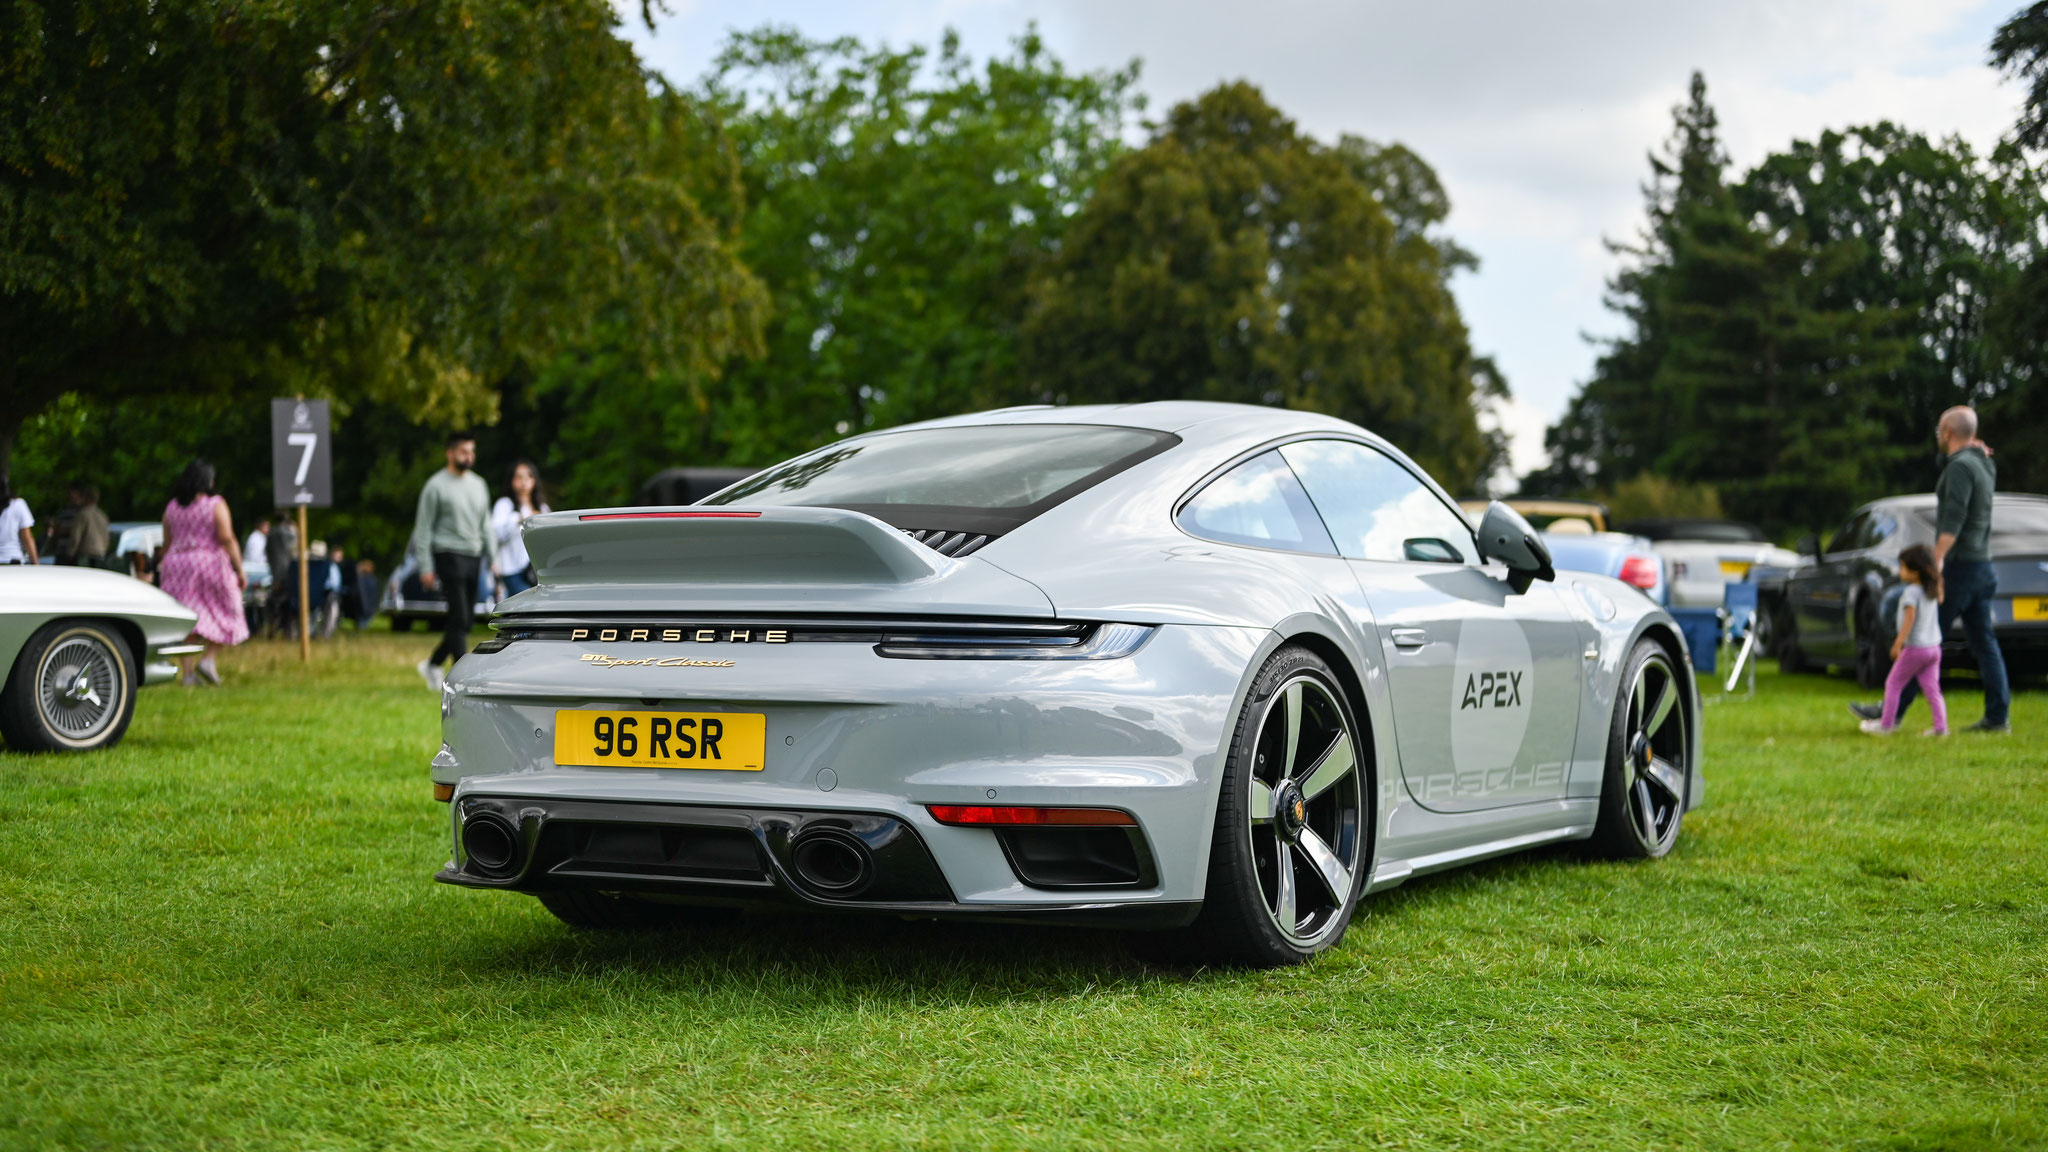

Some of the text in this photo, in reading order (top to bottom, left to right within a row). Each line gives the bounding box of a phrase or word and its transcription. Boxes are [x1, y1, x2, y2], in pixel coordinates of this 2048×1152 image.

[287, 432, 317, 486] 7
[572, 629, 787, 642] PORSCHE
[592, 657, 657, 668] Sport
[656, 658, 736, 667] Classic
[1461, 670, 1523, 710] APEX
[594, 717, 722, 759] 96 RSR
[1380, 761, 1562, 803] PORSCHE
